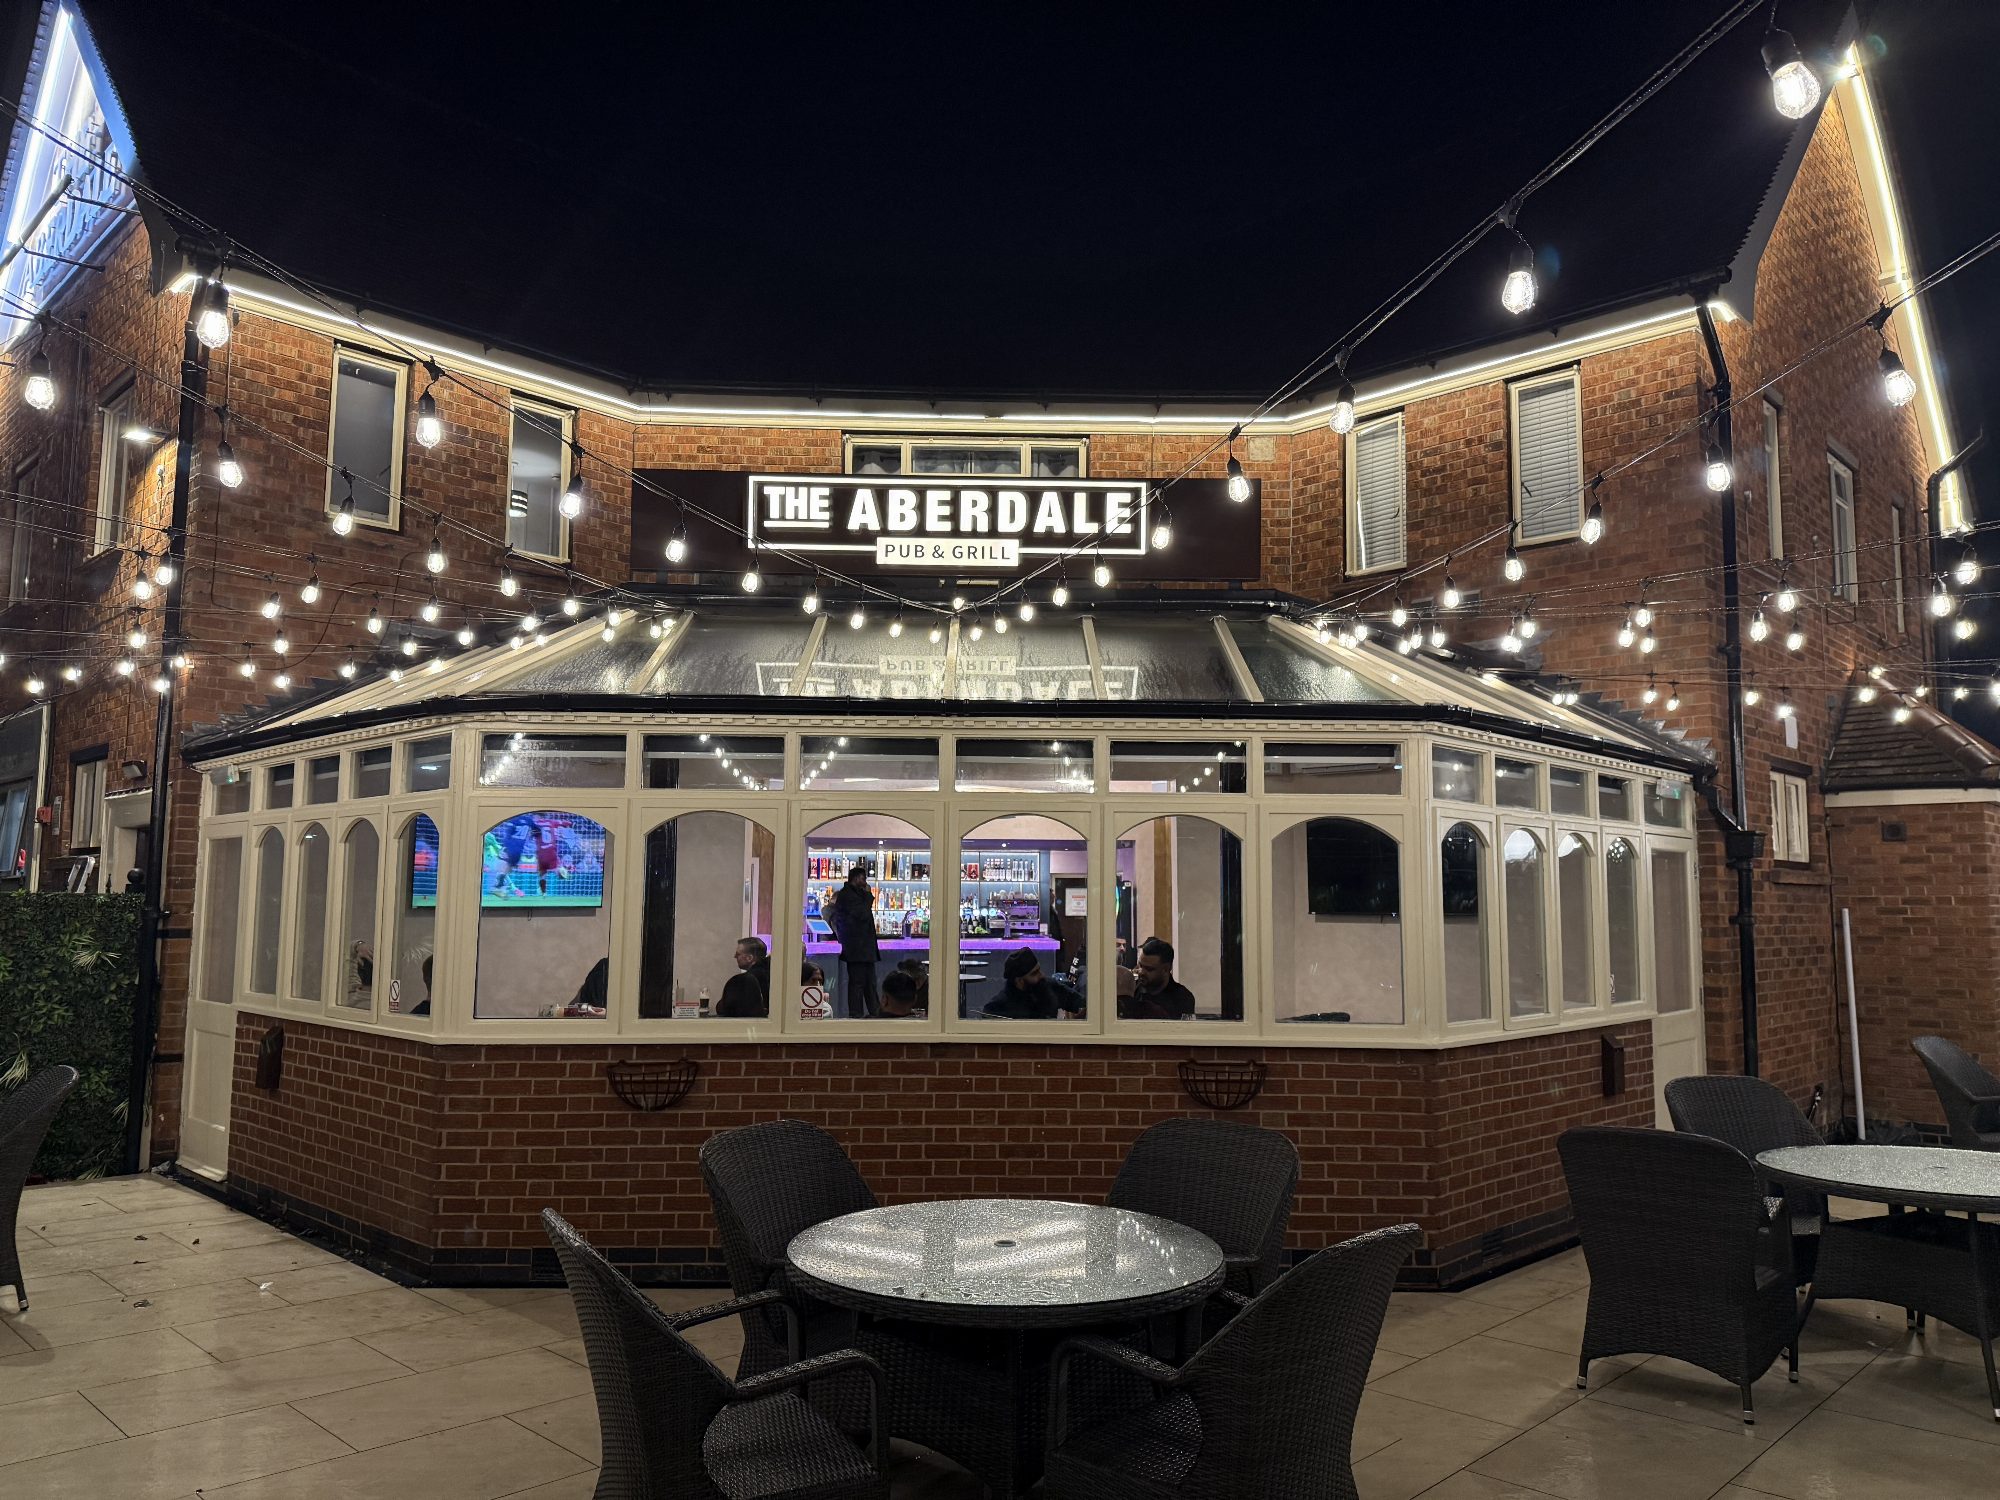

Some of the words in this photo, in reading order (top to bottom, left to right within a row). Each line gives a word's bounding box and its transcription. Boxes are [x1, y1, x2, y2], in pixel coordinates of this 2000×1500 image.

[763, 486, 830, 520] THE
[847, 488, 1132, 533] ABERDALE
[884, 543, 925, 560] PUB
[931, 543, 946, 560] &
[952, 544, 1010, 561] GRILL
